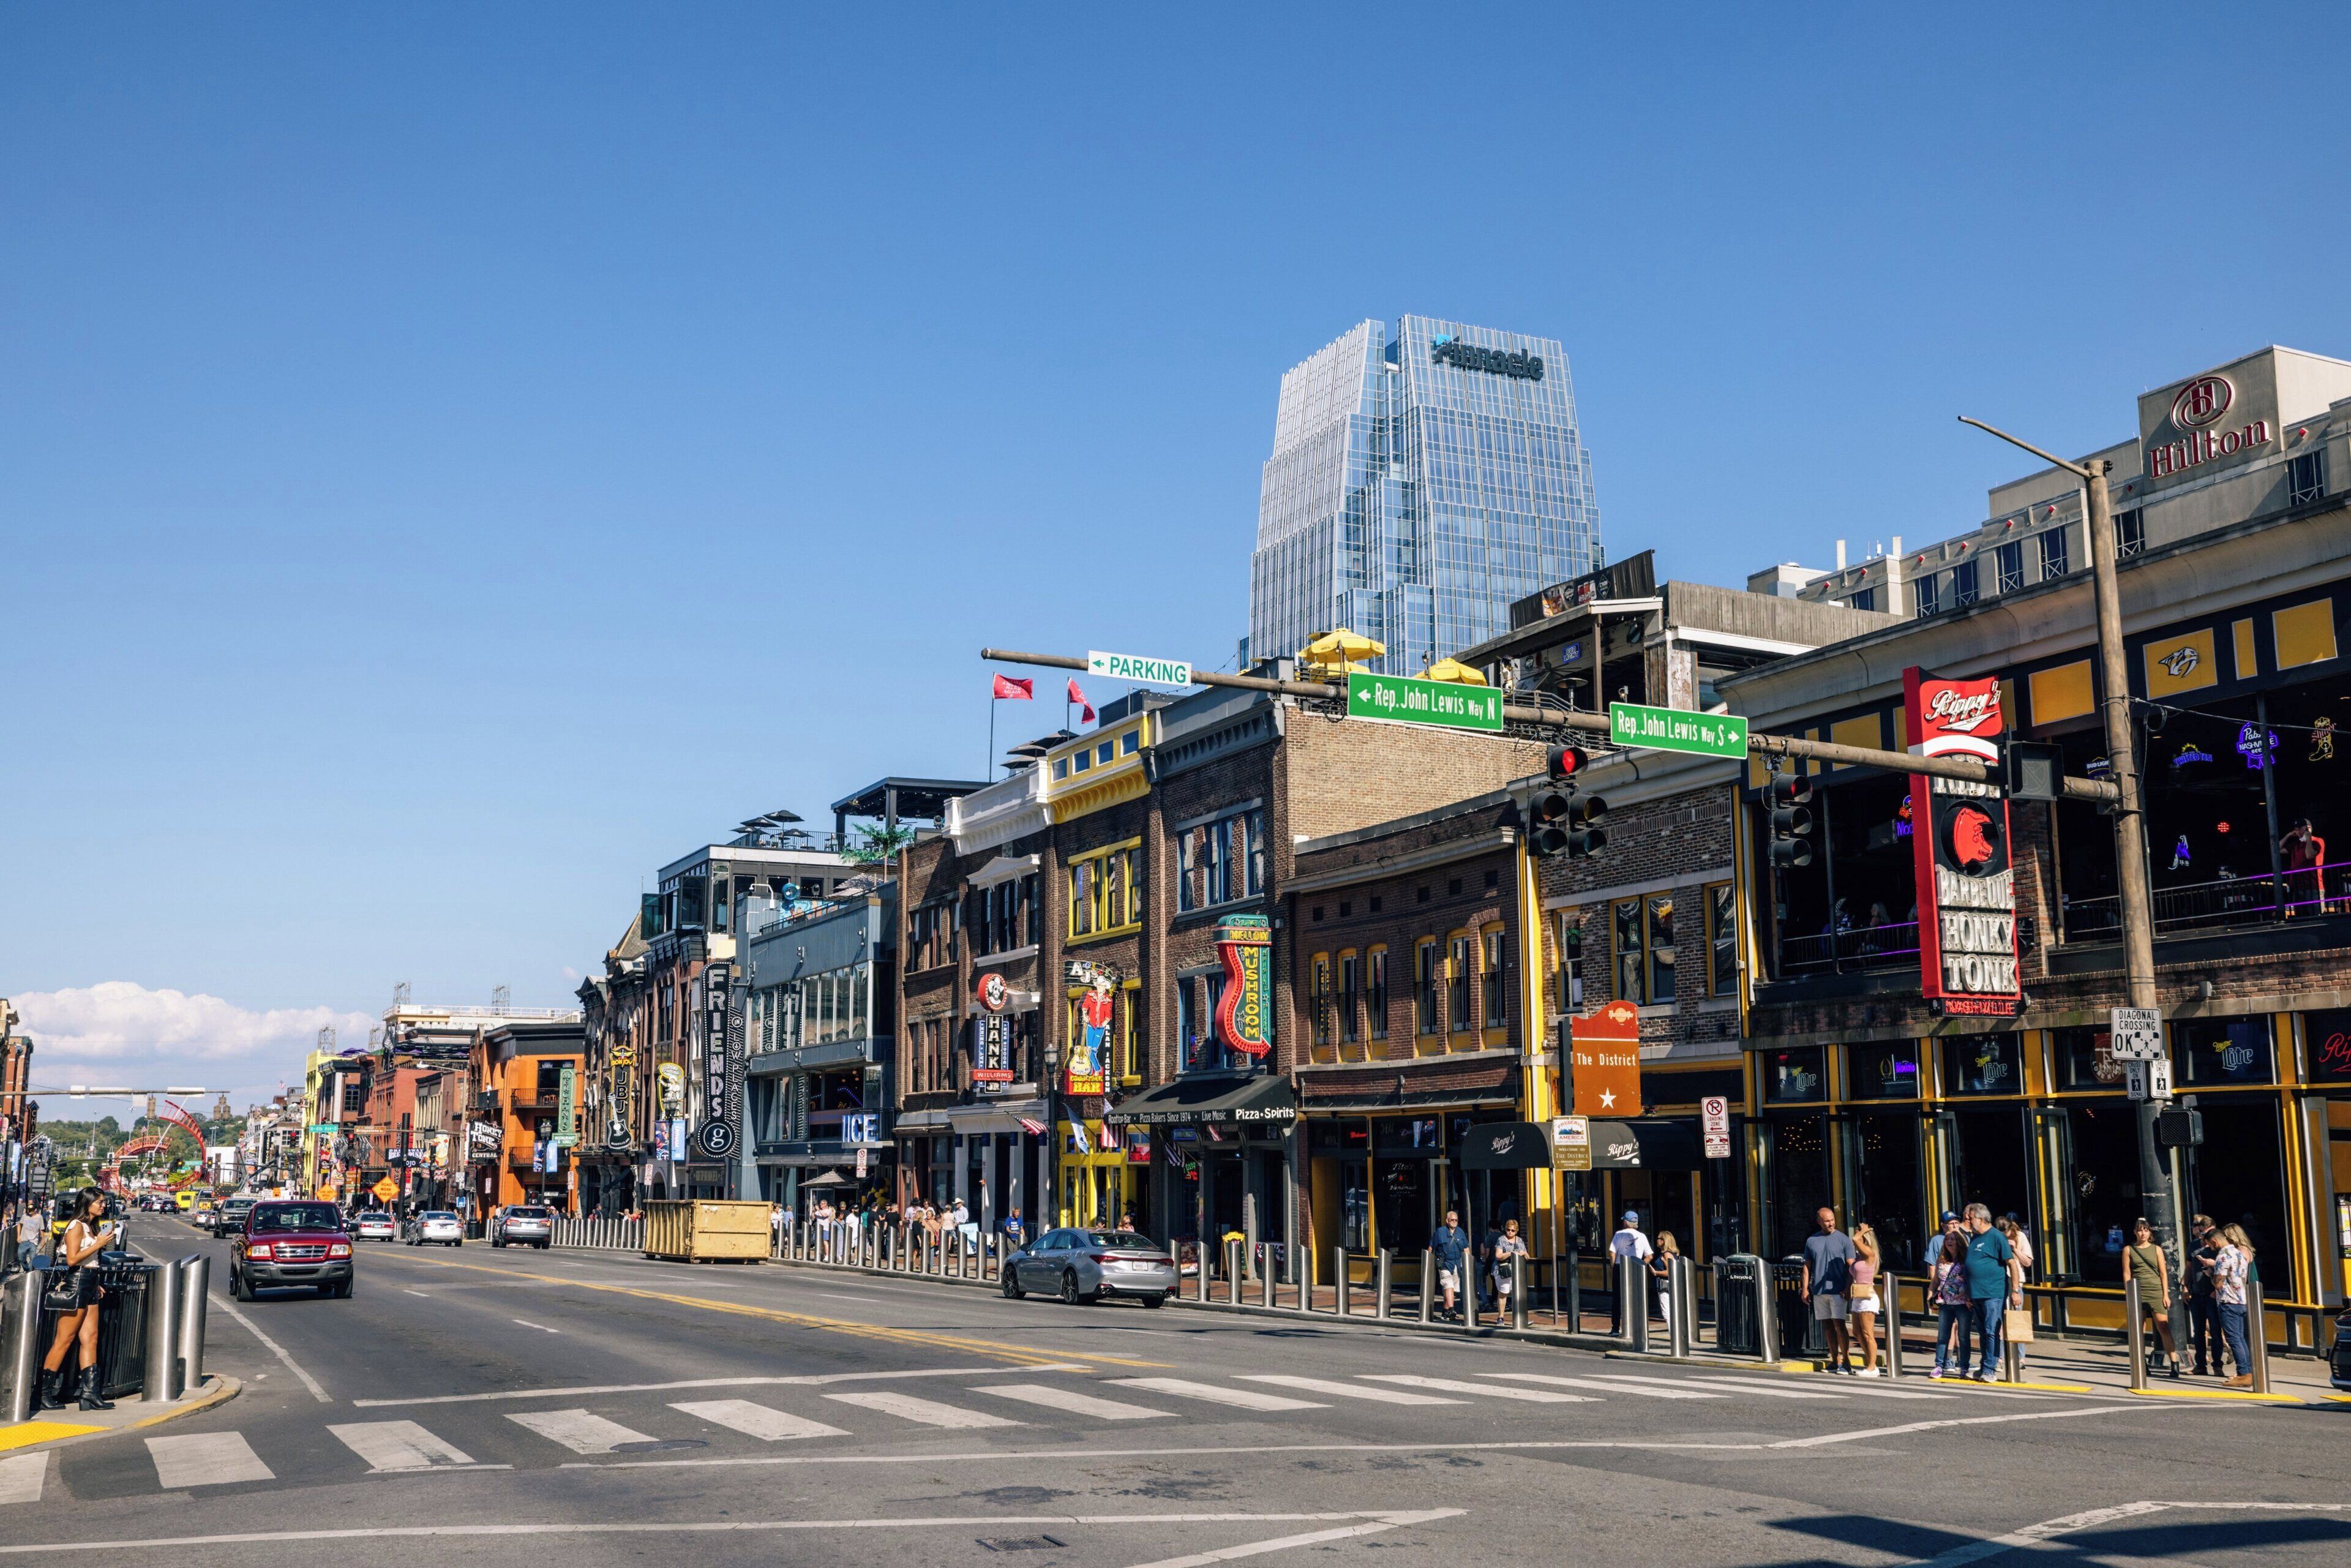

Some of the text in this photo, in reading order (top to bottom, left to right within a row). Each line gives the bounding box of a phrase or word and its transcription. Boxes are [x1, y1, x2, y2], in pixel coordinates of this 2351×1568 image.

[2149, 420, 2273, 480] Hilton
[1109, 656, 1188, 684] PARKING
[1374, 682, 1495, 721] Rep. John Lewis Way N
[1925, 680, 2001, 724] Rippy's
[1618, 710, 1725, 747] Rep. John Lewis Way S
[2173, 753, 2213, 766] TWISTED TEA
[1935, 864, 2016, 909] BARBEQUE
[1229, 930, 1268, 941] MELLOW
[1940, 910, 2014, 953] HONKY
[1943, 953, 2019, 992] TONK
[1245, 947, 1259, 1038] MUSHROOM
[1945, 999, 2015, 1016] NASHVILLE
[2118, 1010, 2156, 1021] DIAGONAL
[2119, 1020, 2156, 1031] CROSSING
[708, 969, 727, 1118] FRIENDS
[988, 1016, 1000, 1069] HANK
[2115, 1033, 2134, 1052] OK
[1577, 1052, 1637, 1066] The District
[2222, 1046, 2254, 1071] Lite
[1796, 1072, 1817, 1092] Lite
[1983, 1062, 2008, 1083] Lite
[730, 1064, 740, 1120] PLACES
[986, 1082, 1000, 1090] JR
[1073, 1082, 1101, 1093] BAR
[1108, 1116, 1124, 1124] Rooftop
[1139, 1114, 1150, 1123] Pizza
[1151, 1113, 1166, 1123] Bakers
[1167, 1112, 1179, 1122] Since
[1180, 1112, 1191, 1121] 1974
[1201, 1111, 1212, 1121] Live
[1212, 1110, 1226, 1121] Music
[1235, 1106, 1295, 1120] Pizza Spirits
[474, 1121, 503, 1138] HONKY
[1557, 1120, 1583, 1129] PRESERVE
[470, 1131, 495, 1146] TONK
[1491, 1131, 1515, 1150] Rippy's
[1607, 1139, 1639, 1157] Rippy's
